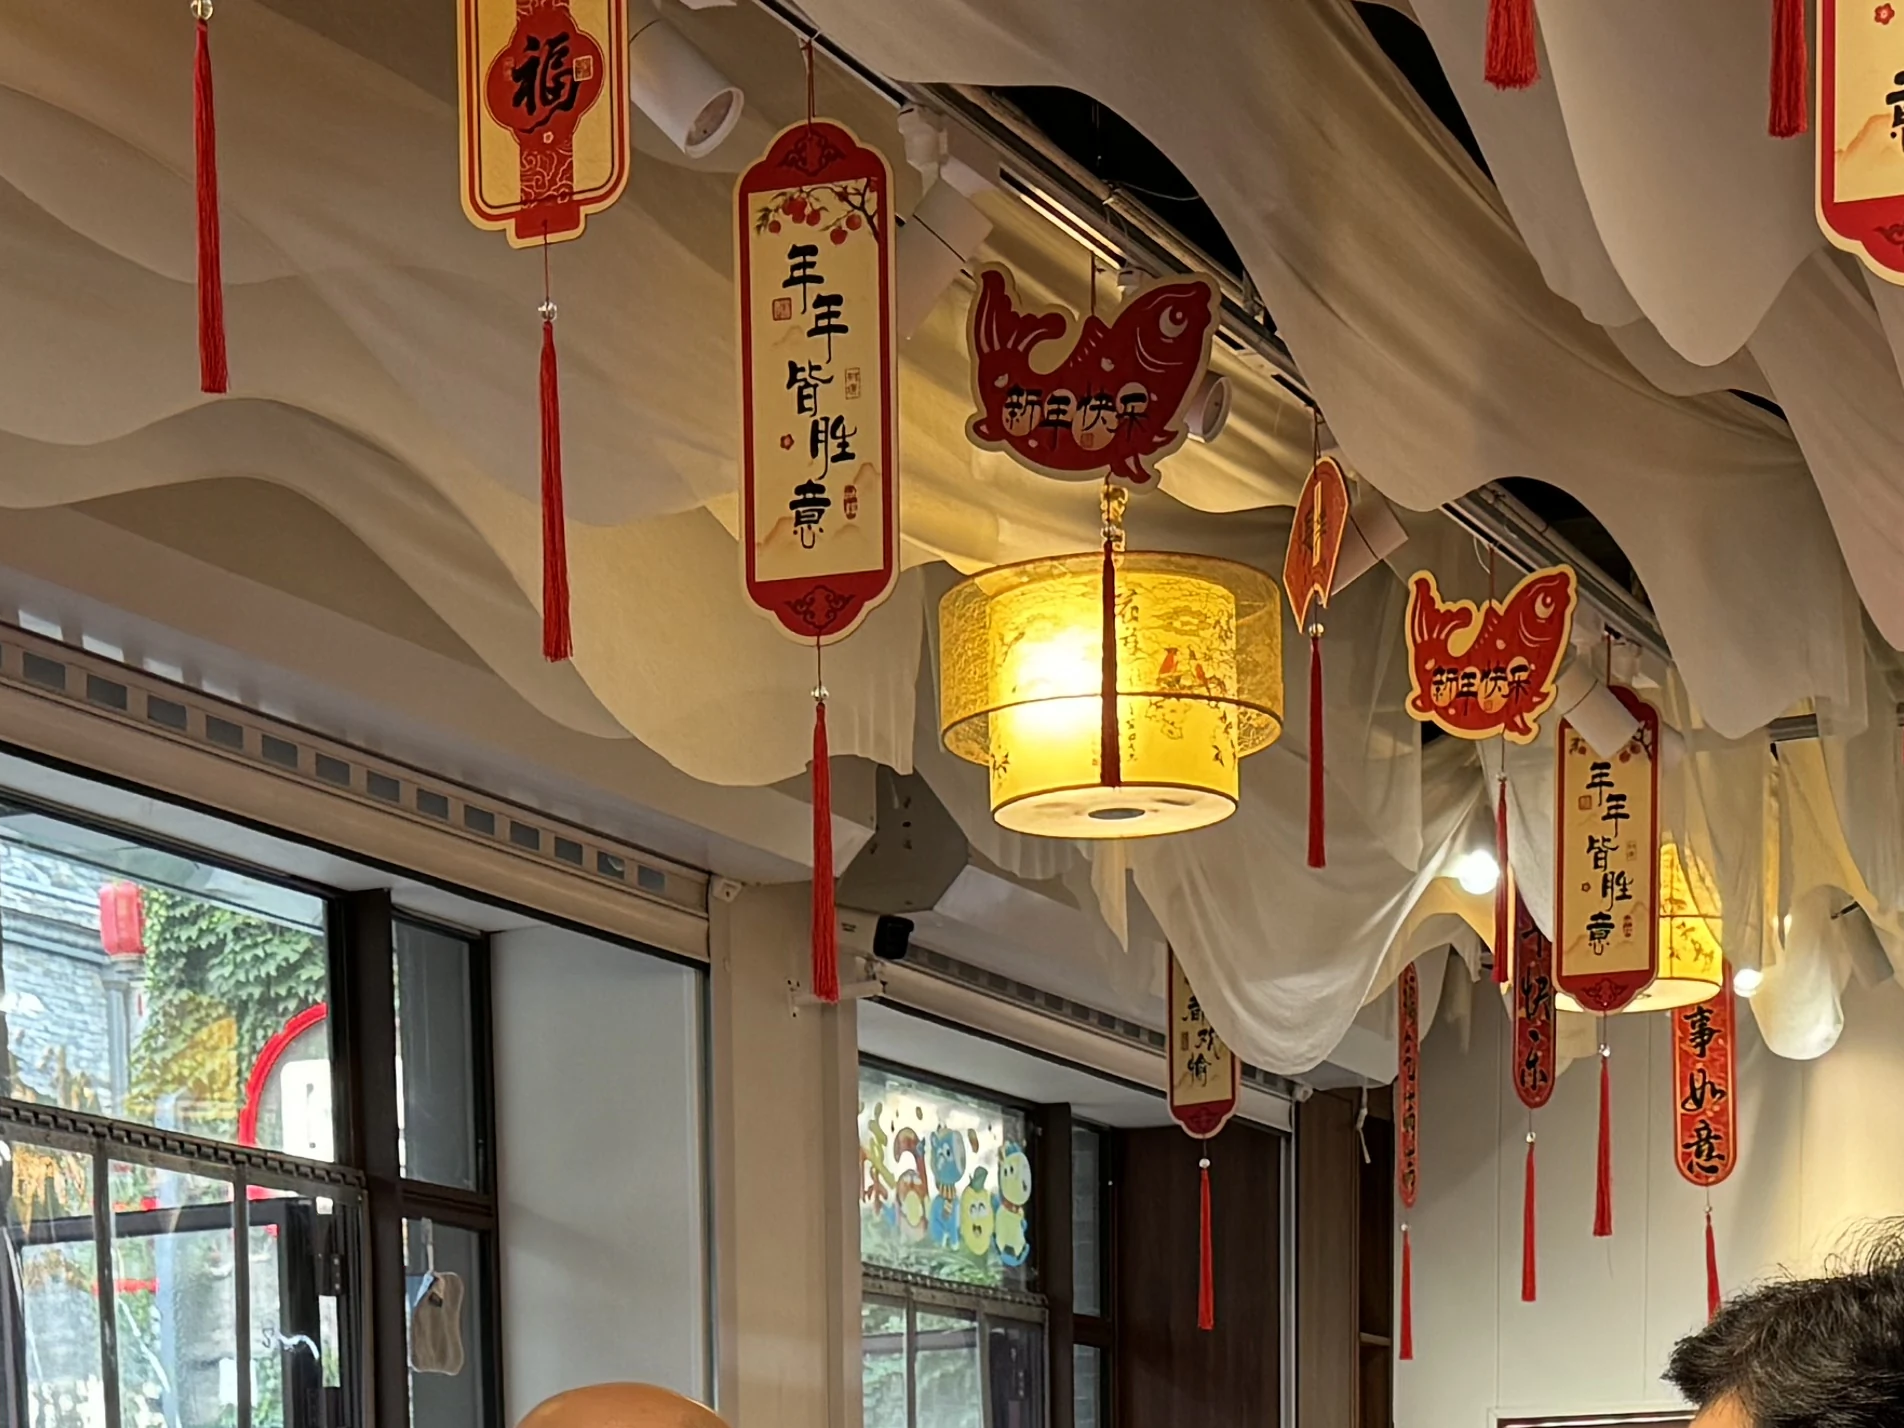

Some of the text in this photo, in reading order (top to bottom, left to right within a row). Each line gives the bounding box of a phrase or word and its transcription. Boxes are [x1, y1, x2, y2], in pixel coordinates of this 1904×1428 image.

[512, 31, 582, 134] 福
[781, 243, 858, 549] 年年皆胜意
[1001, 383, 1151, 438] 新年快乐
[1586, 762, 1634, 956] 年年皆胜意
